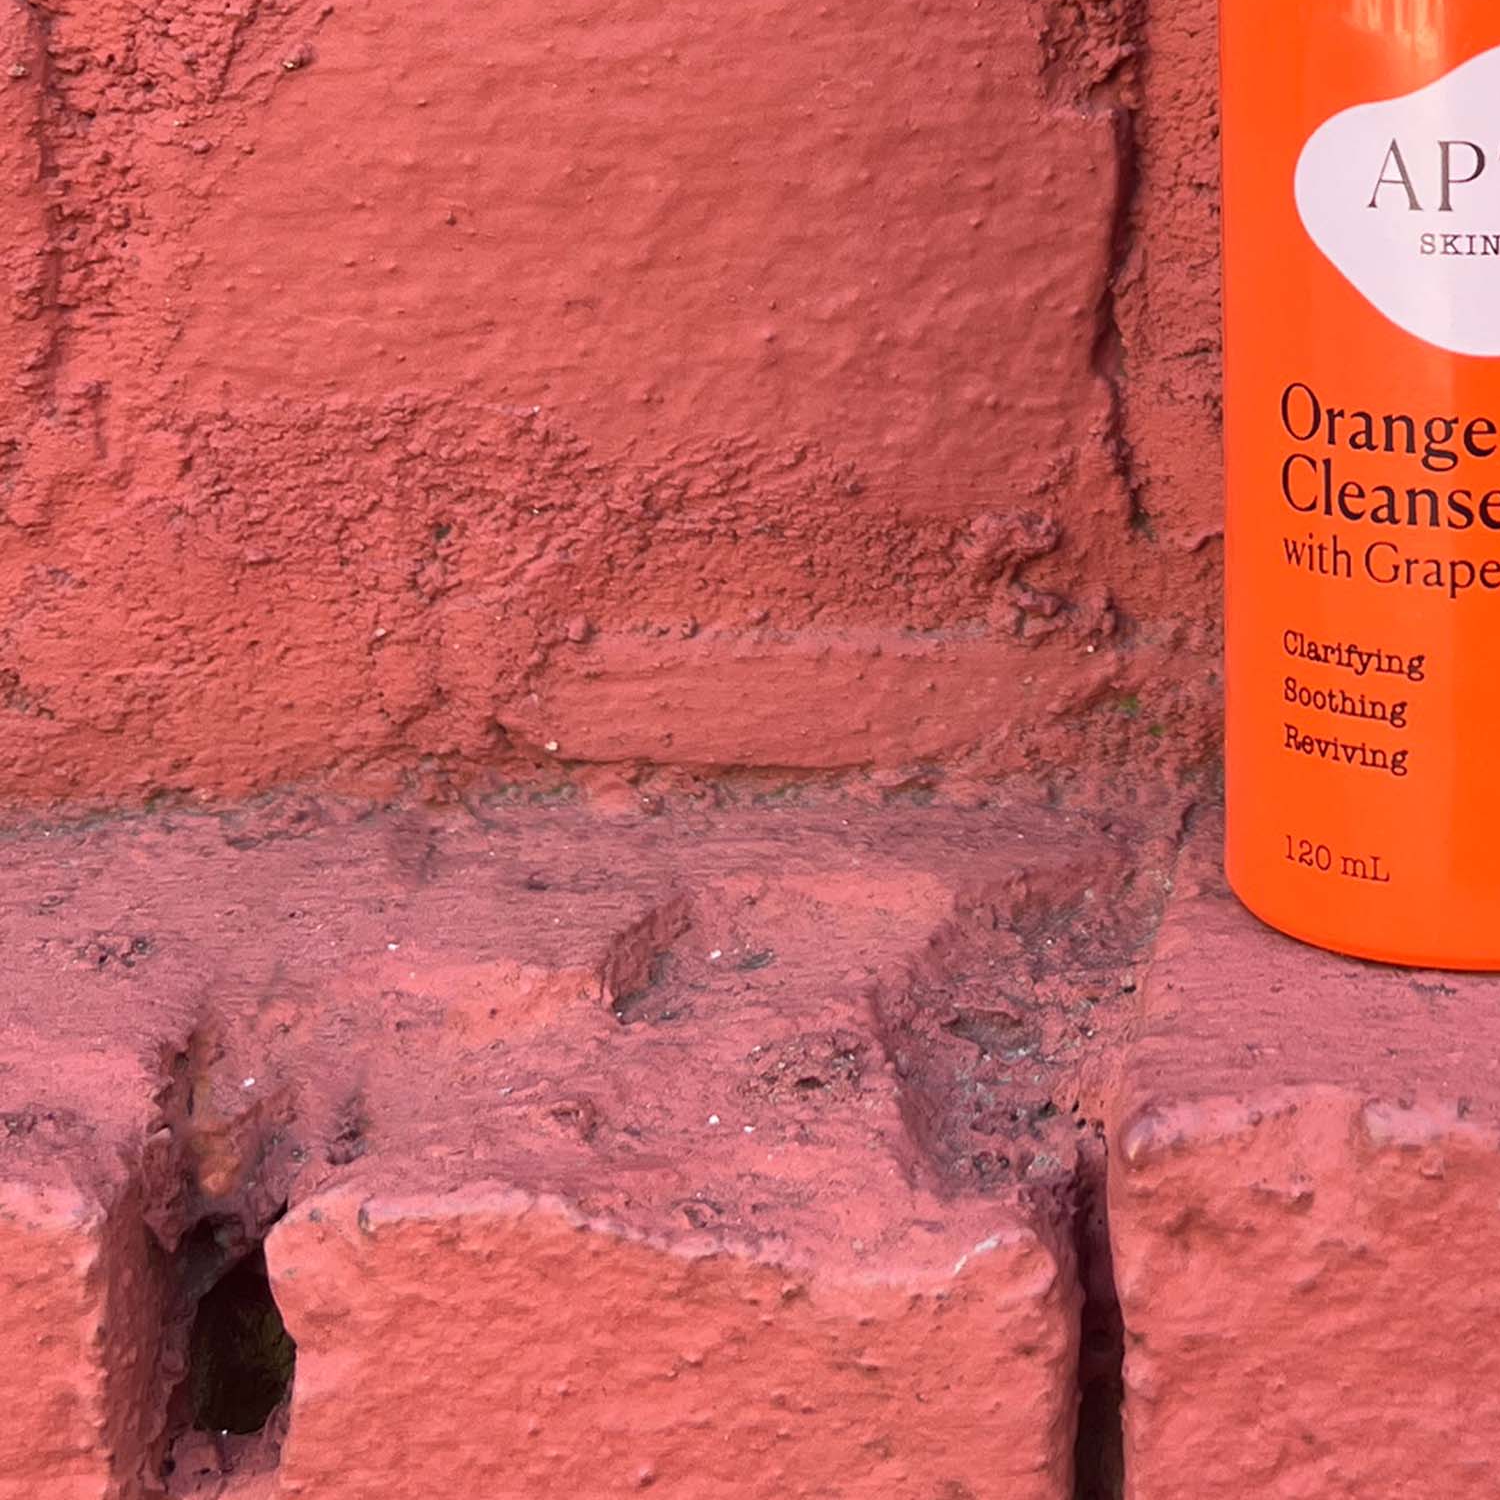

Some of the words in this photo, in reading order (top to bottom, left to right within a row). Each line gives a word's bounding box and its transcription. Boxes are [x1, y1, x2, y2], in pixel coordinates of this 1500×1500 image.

[1281, 382, 1497, 472] Orange
[1283, 532, 1352, 578] with
[1283, 629, 1425, 682] Clarifying
[1284, 676, 1408, 729] Soothing
[1284, 723, 1408, 777] Reviving
[1286, 834, 1332, 871] 120
[1340, 855, 1390, 882] mL
